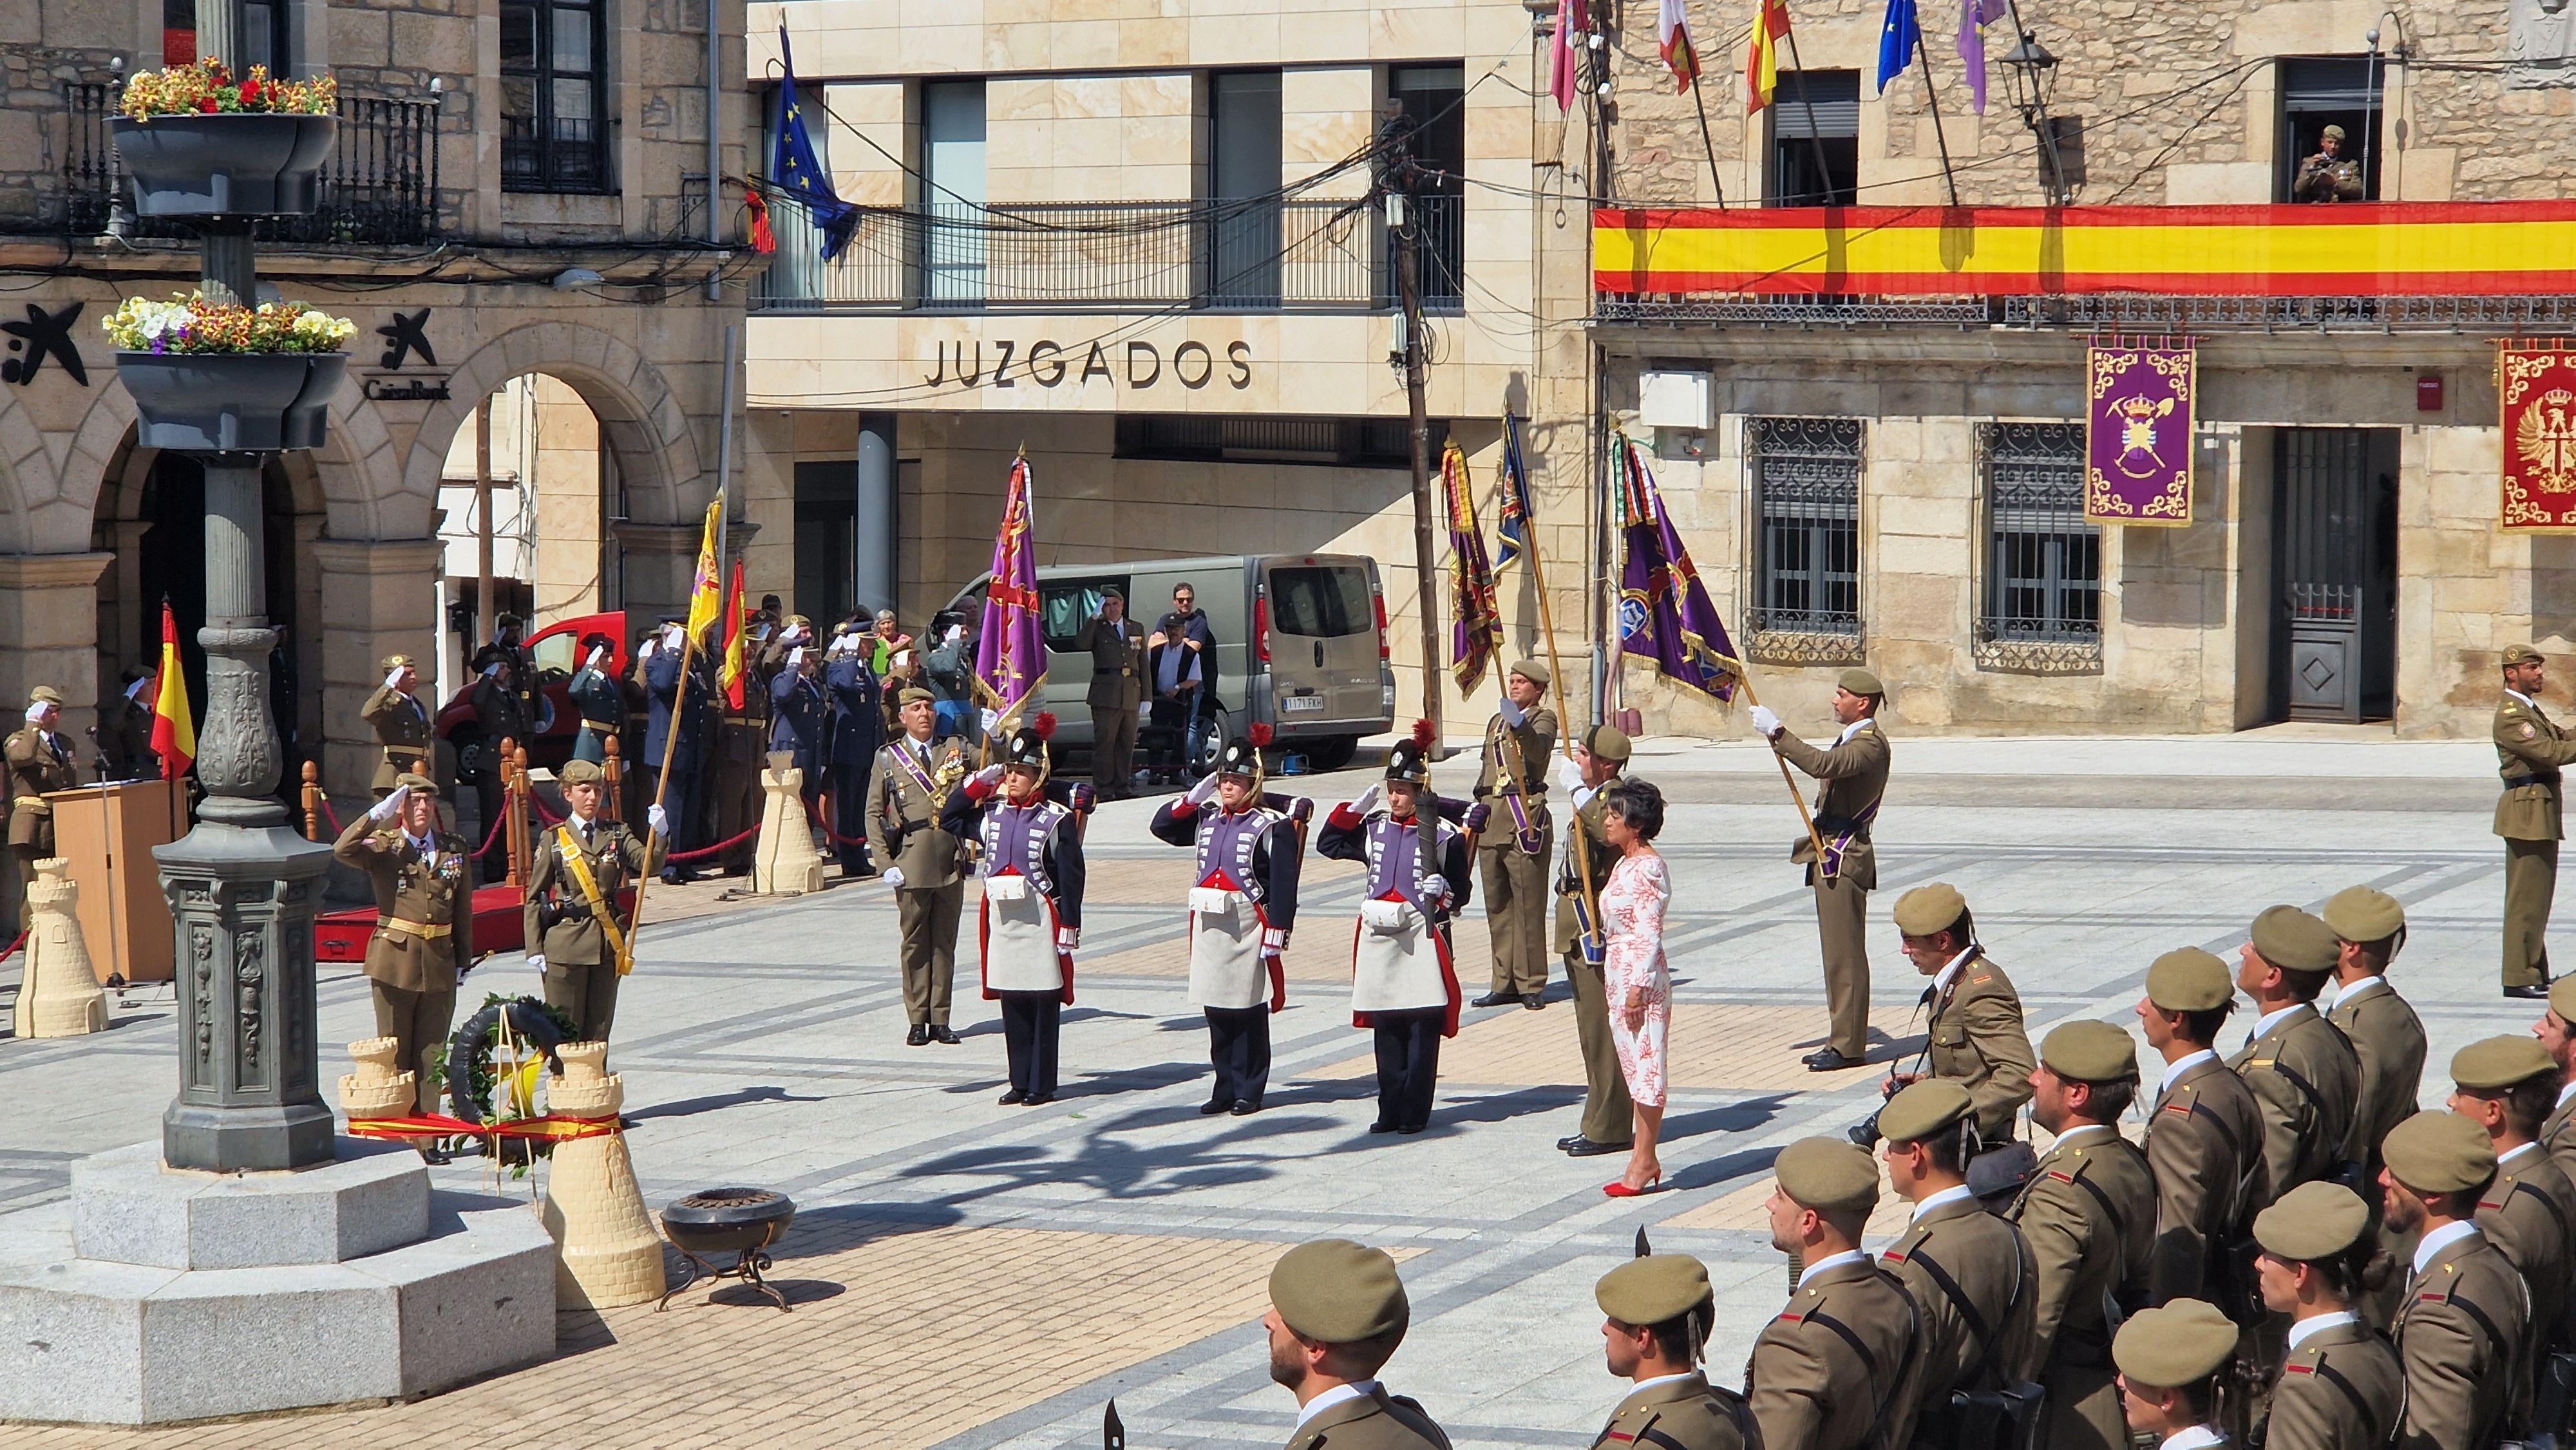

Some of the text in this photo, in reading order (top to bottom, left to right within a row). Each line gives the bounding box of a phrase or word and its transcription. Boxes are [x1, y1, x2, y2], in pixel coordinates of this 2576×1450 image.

[923, 340, 1251, 390] JUZGADOS
[1289, 698, 1322, 708] 1171 FKH
